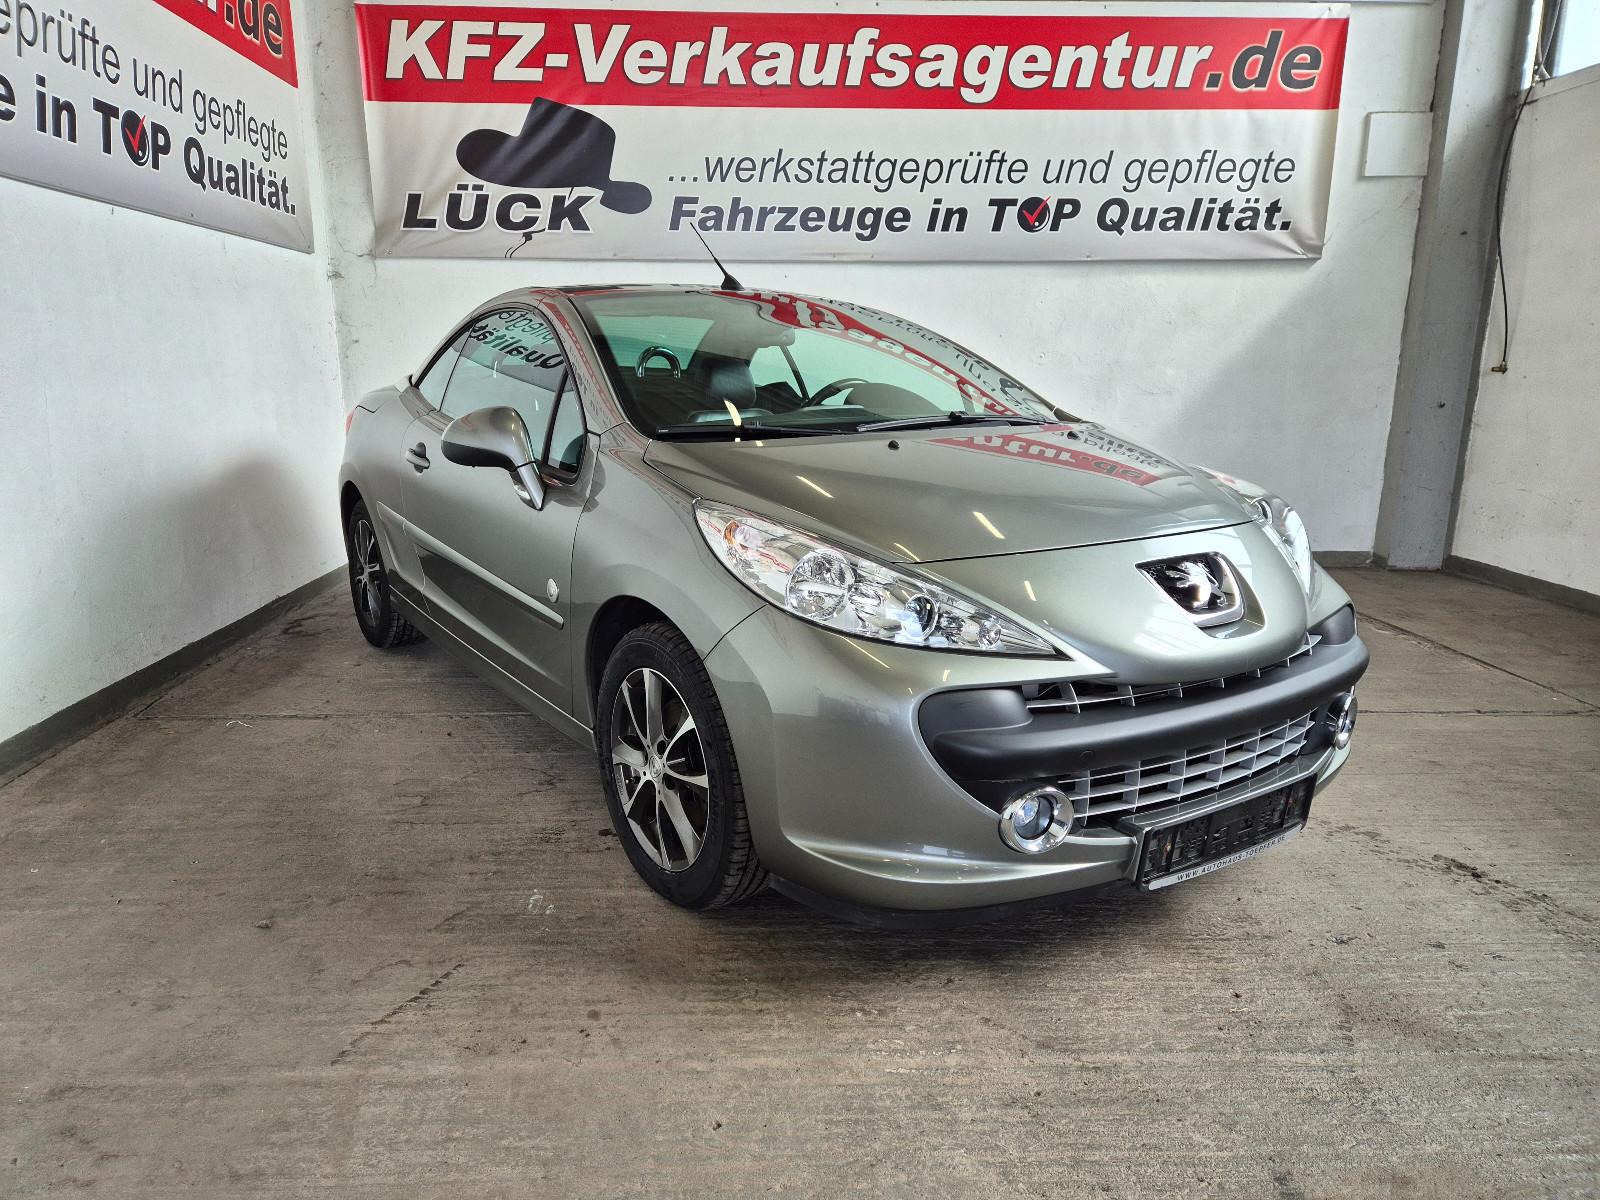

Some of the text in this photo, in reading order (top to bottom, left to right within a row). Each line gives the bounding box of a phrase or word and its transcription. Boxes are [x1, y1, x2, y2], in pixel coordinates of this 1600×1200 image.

[207, 0, 283, 56] .de
[385, 18, 1322, 104] KFZ-Verkaufsagentur.de
[132, 58, 184, 114] und
[193, 89, 288, 162] gepflegte
[35, 73, 77, 143] in
[93, 97, 171, 171] TOP
[184, 137, 296, 215] Qualität.
[1042, 150, 1115, 184] und
[1122, 150, 1296, 192] gepflegte
[402, 184, 596, 232] LÜCK
[668, 196, 1292, 241] Fahrzeuge in TOP Qualität.
